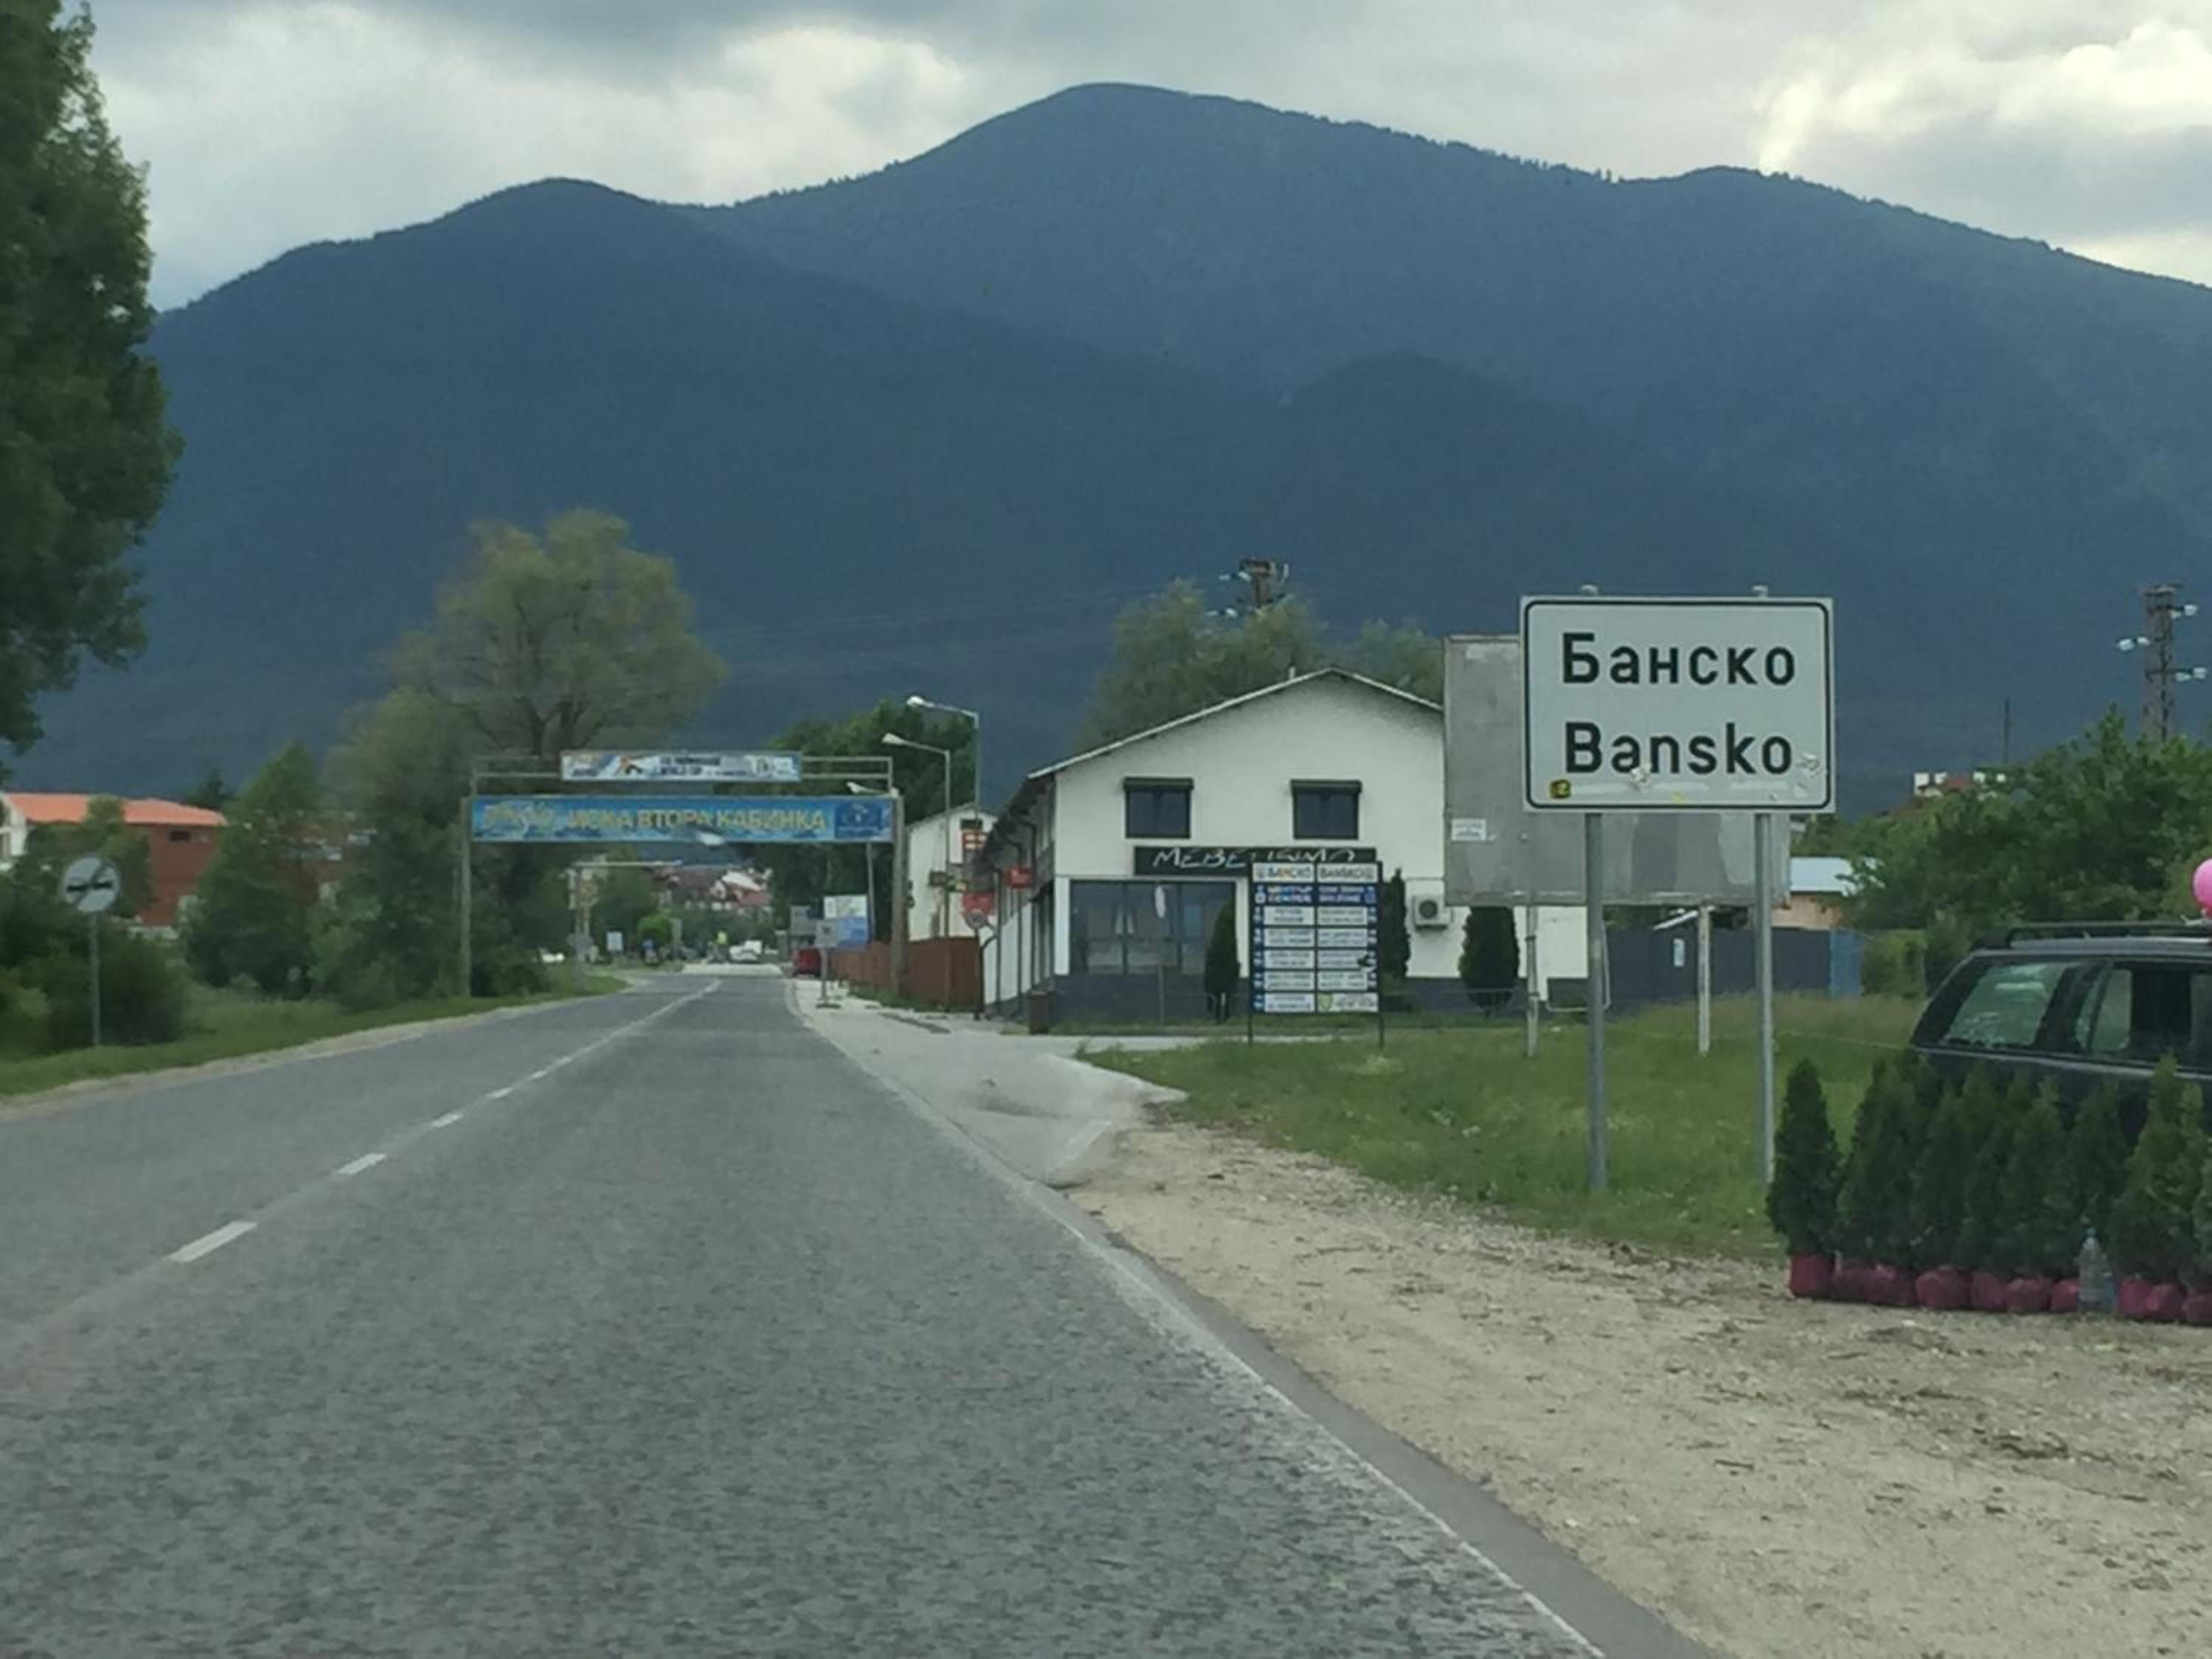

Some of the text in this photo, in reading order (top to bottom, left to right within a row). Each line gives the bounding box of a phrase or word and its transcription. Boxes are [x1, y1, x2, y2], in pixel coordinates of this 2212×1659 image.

[1562, 632, 1795, 686] Банско
[1565, 721, 1792, 775] Bansko
[636, 809, 711, 829] ВТОРА
